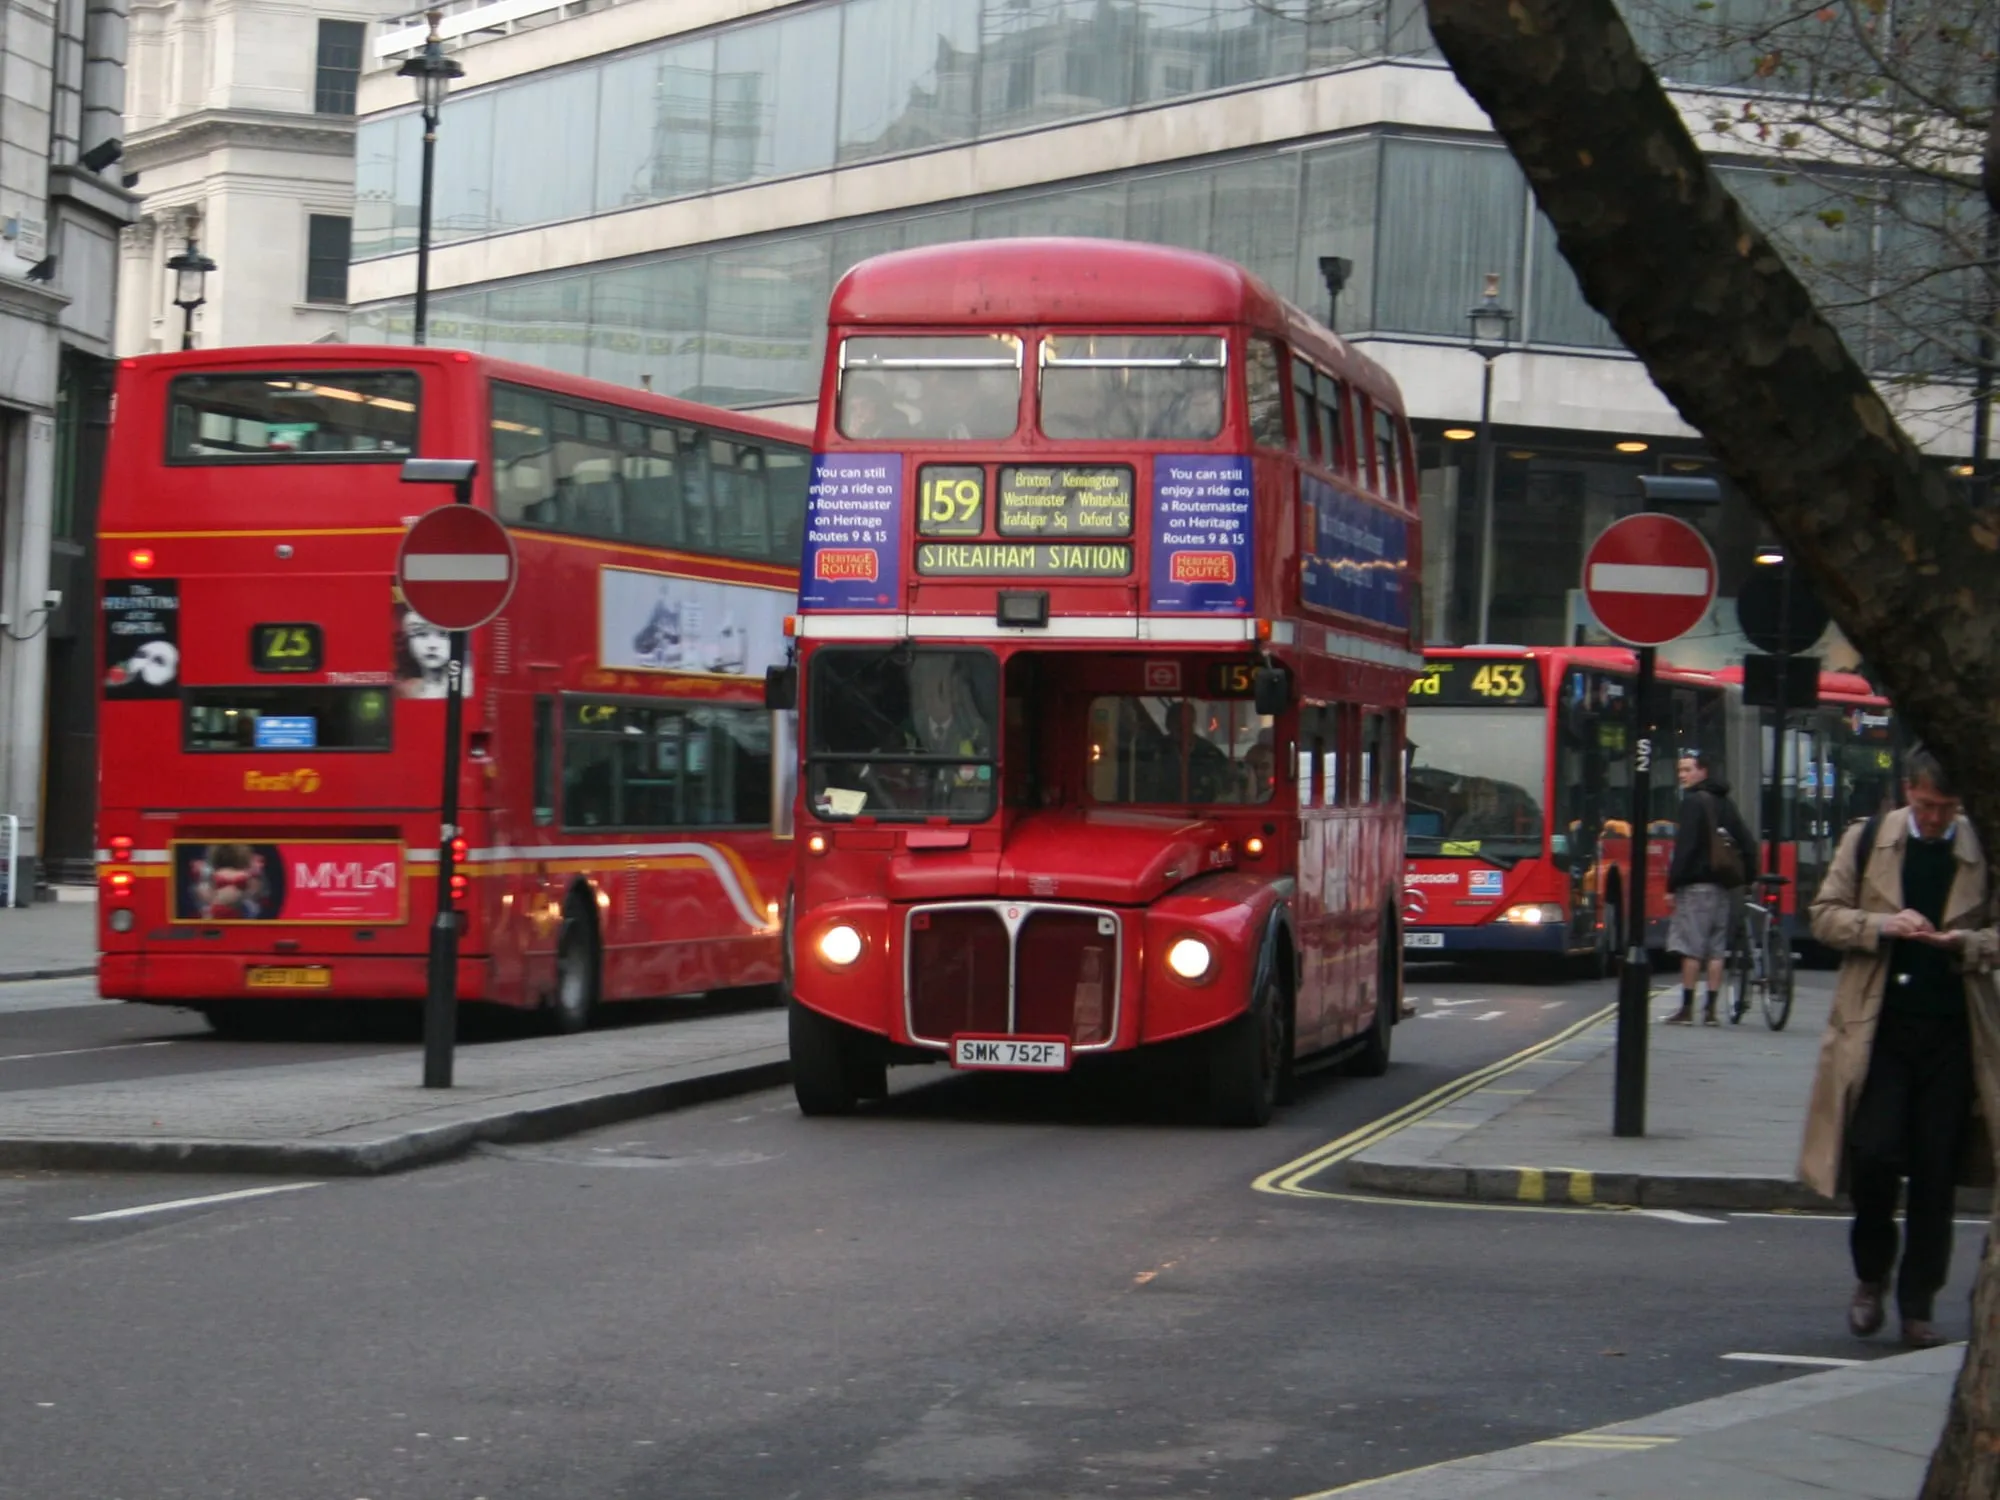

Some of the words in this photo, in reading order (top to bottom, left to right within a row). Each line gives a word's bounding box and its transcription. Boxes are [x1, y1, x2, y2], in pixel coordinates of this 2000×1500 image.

[816, 467, 837, 478] You
[840, 470, 861, 478] can
[864, 467, 886, 479] still
[1169, 467, 1193, 480] You
[1195, 470, 1217, 480] can
[1219, 469, 1243, 480] still
[1015, 471, 1052, 488] Brixton
[1063, 471, 1120, 490] Kennington
[809, 483, 839, 496] enjoy
[841, 486, 848, 494] a
[851, 483, 874, 494] ride
[876, 486, 893, 494] on
[1161, 485, 1194, 498] enjoy
[1197, 486, 1204, 496] a
[1207, 485, 1230, 496] ride
[1233, 487, 1250, 497] on
[808, 501, 815, 510] a
[817, 499, 891, 510] Routemaster
[922, 480, 981, 522] 159
[1004, 491, 1067, 508] Westminster
[1079, 491, 1130, 508] Whitehall
[1161, 502, 1169, 512] a
[1171, 500, 1248, 513] Routemaster
[814, 517, 830, 525] on
[833, 514, 882, 528] Heritage
[1003, 510, 1048, 529] Trafalgar
[1053, 510, 1068, 528] Sq
[1079, 511, 1113, 527] Oxford
[1118, 511, 1130, 528] St
[1169, 518, 1186, 528] on
[1188, 516, 1240, 530] Heritage
[809, 530, 849, 541] Routes
[852, 530, 860, 541] 9
[862, 530, 872, 542] &
[875, 531, 888, 542] 15
[1163, 532, 1205, 544] Routes
[1208, 533, 1216, 544] 9
[1219, 533, 1229, 544] &
[1232, 533, 1245, 545] 15
[821, 553, 873, 564] HERITAGE
[923, 545, 1036, 569] STREATHAM
[1048, 546, 1125, 569] STATION
[821, 563, 873, 576] ROUTES
[1176, 565, 1230, 578] ROUTES
[1408, 673, 1440, 695] rd
[1471, 664, 1526, 697] 453
[1404, 873, 1460, 887] gecoach
[963, 1042, 1000, 1061] SMK
[1006, 1044, 1055, 1063] 752F
